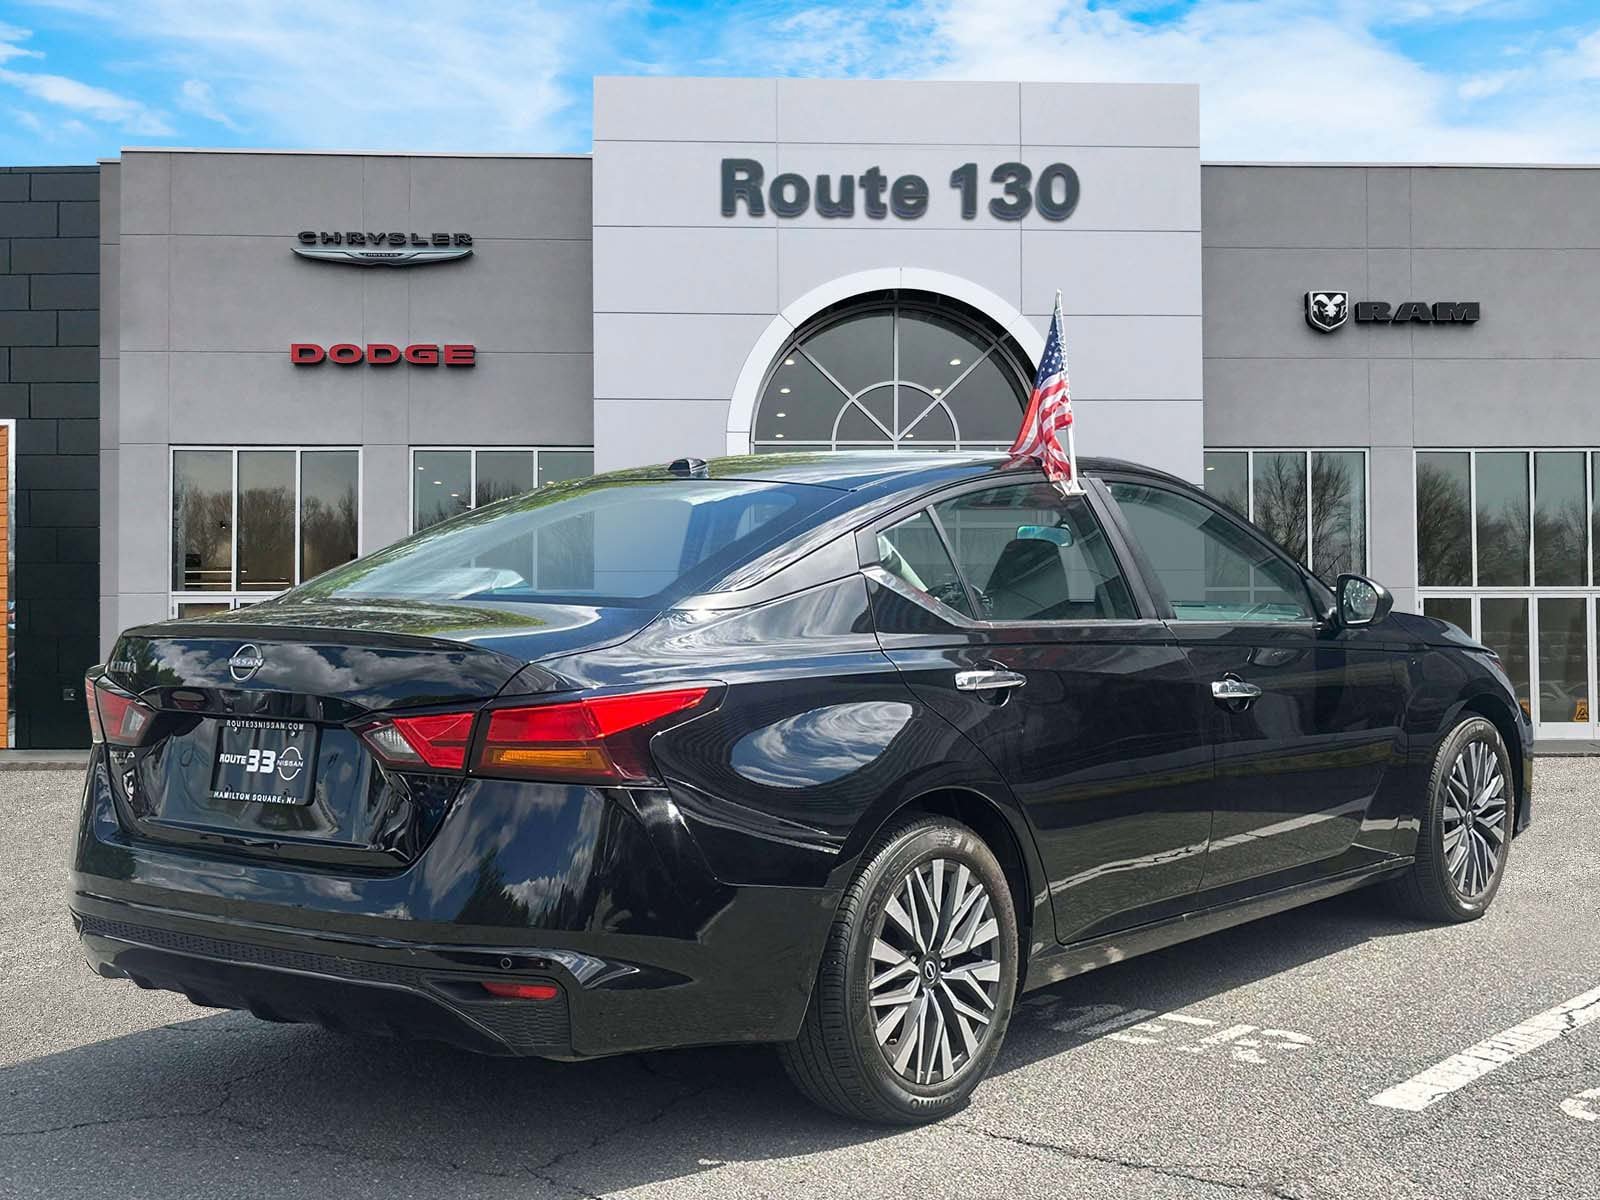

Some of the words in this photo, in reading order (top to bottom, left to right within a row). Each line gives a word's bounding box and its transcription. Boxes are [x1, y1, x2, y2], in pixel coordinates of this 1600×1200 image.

[721, 158, 929, 219] Route
[950, 162, 1081, 222] 130
[298, 231, 473, 246] CHRYSLER
[1354, 301, 1480, 323] RAM
[291, 343, 476, 366] DODGE
[228, 657, 265, 668] NISSAN
[226, 719, 305, 731] ROUTE33NISSAN.COM
[219, 753, 247, 765] ROUTE
[246, 748, 277, 774] 33
[276, 760, 304, 768] NISSAN
[213, 791, 250, 801] HAMILTON
[286, 796, 297, 805] NJ
